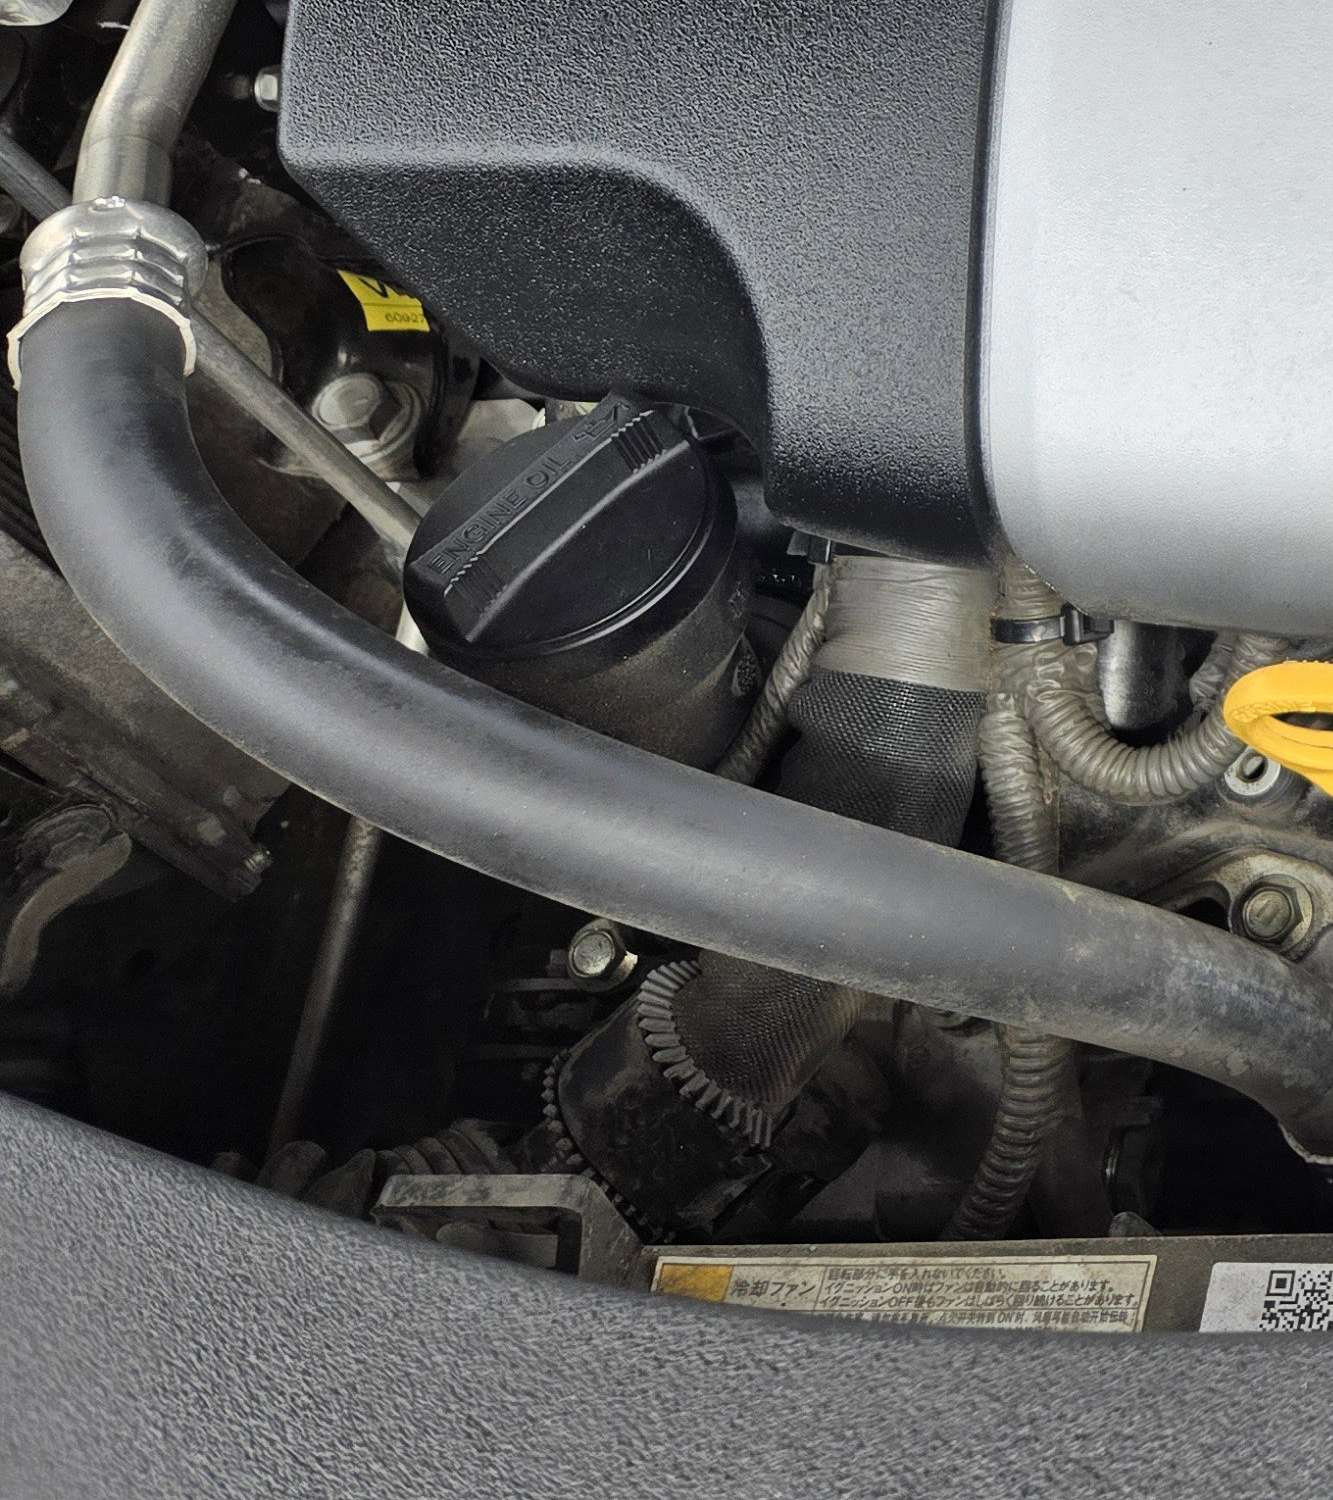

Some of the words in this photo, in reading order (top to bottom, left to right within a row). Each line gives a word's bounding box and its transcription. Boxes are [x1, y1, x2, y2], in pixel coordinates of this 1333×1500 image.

[427, 490, 528, 575] ENGINE
[525, 455, 571, 489] OIL
[731, 1279, 816, 1298] 冷却ファン
